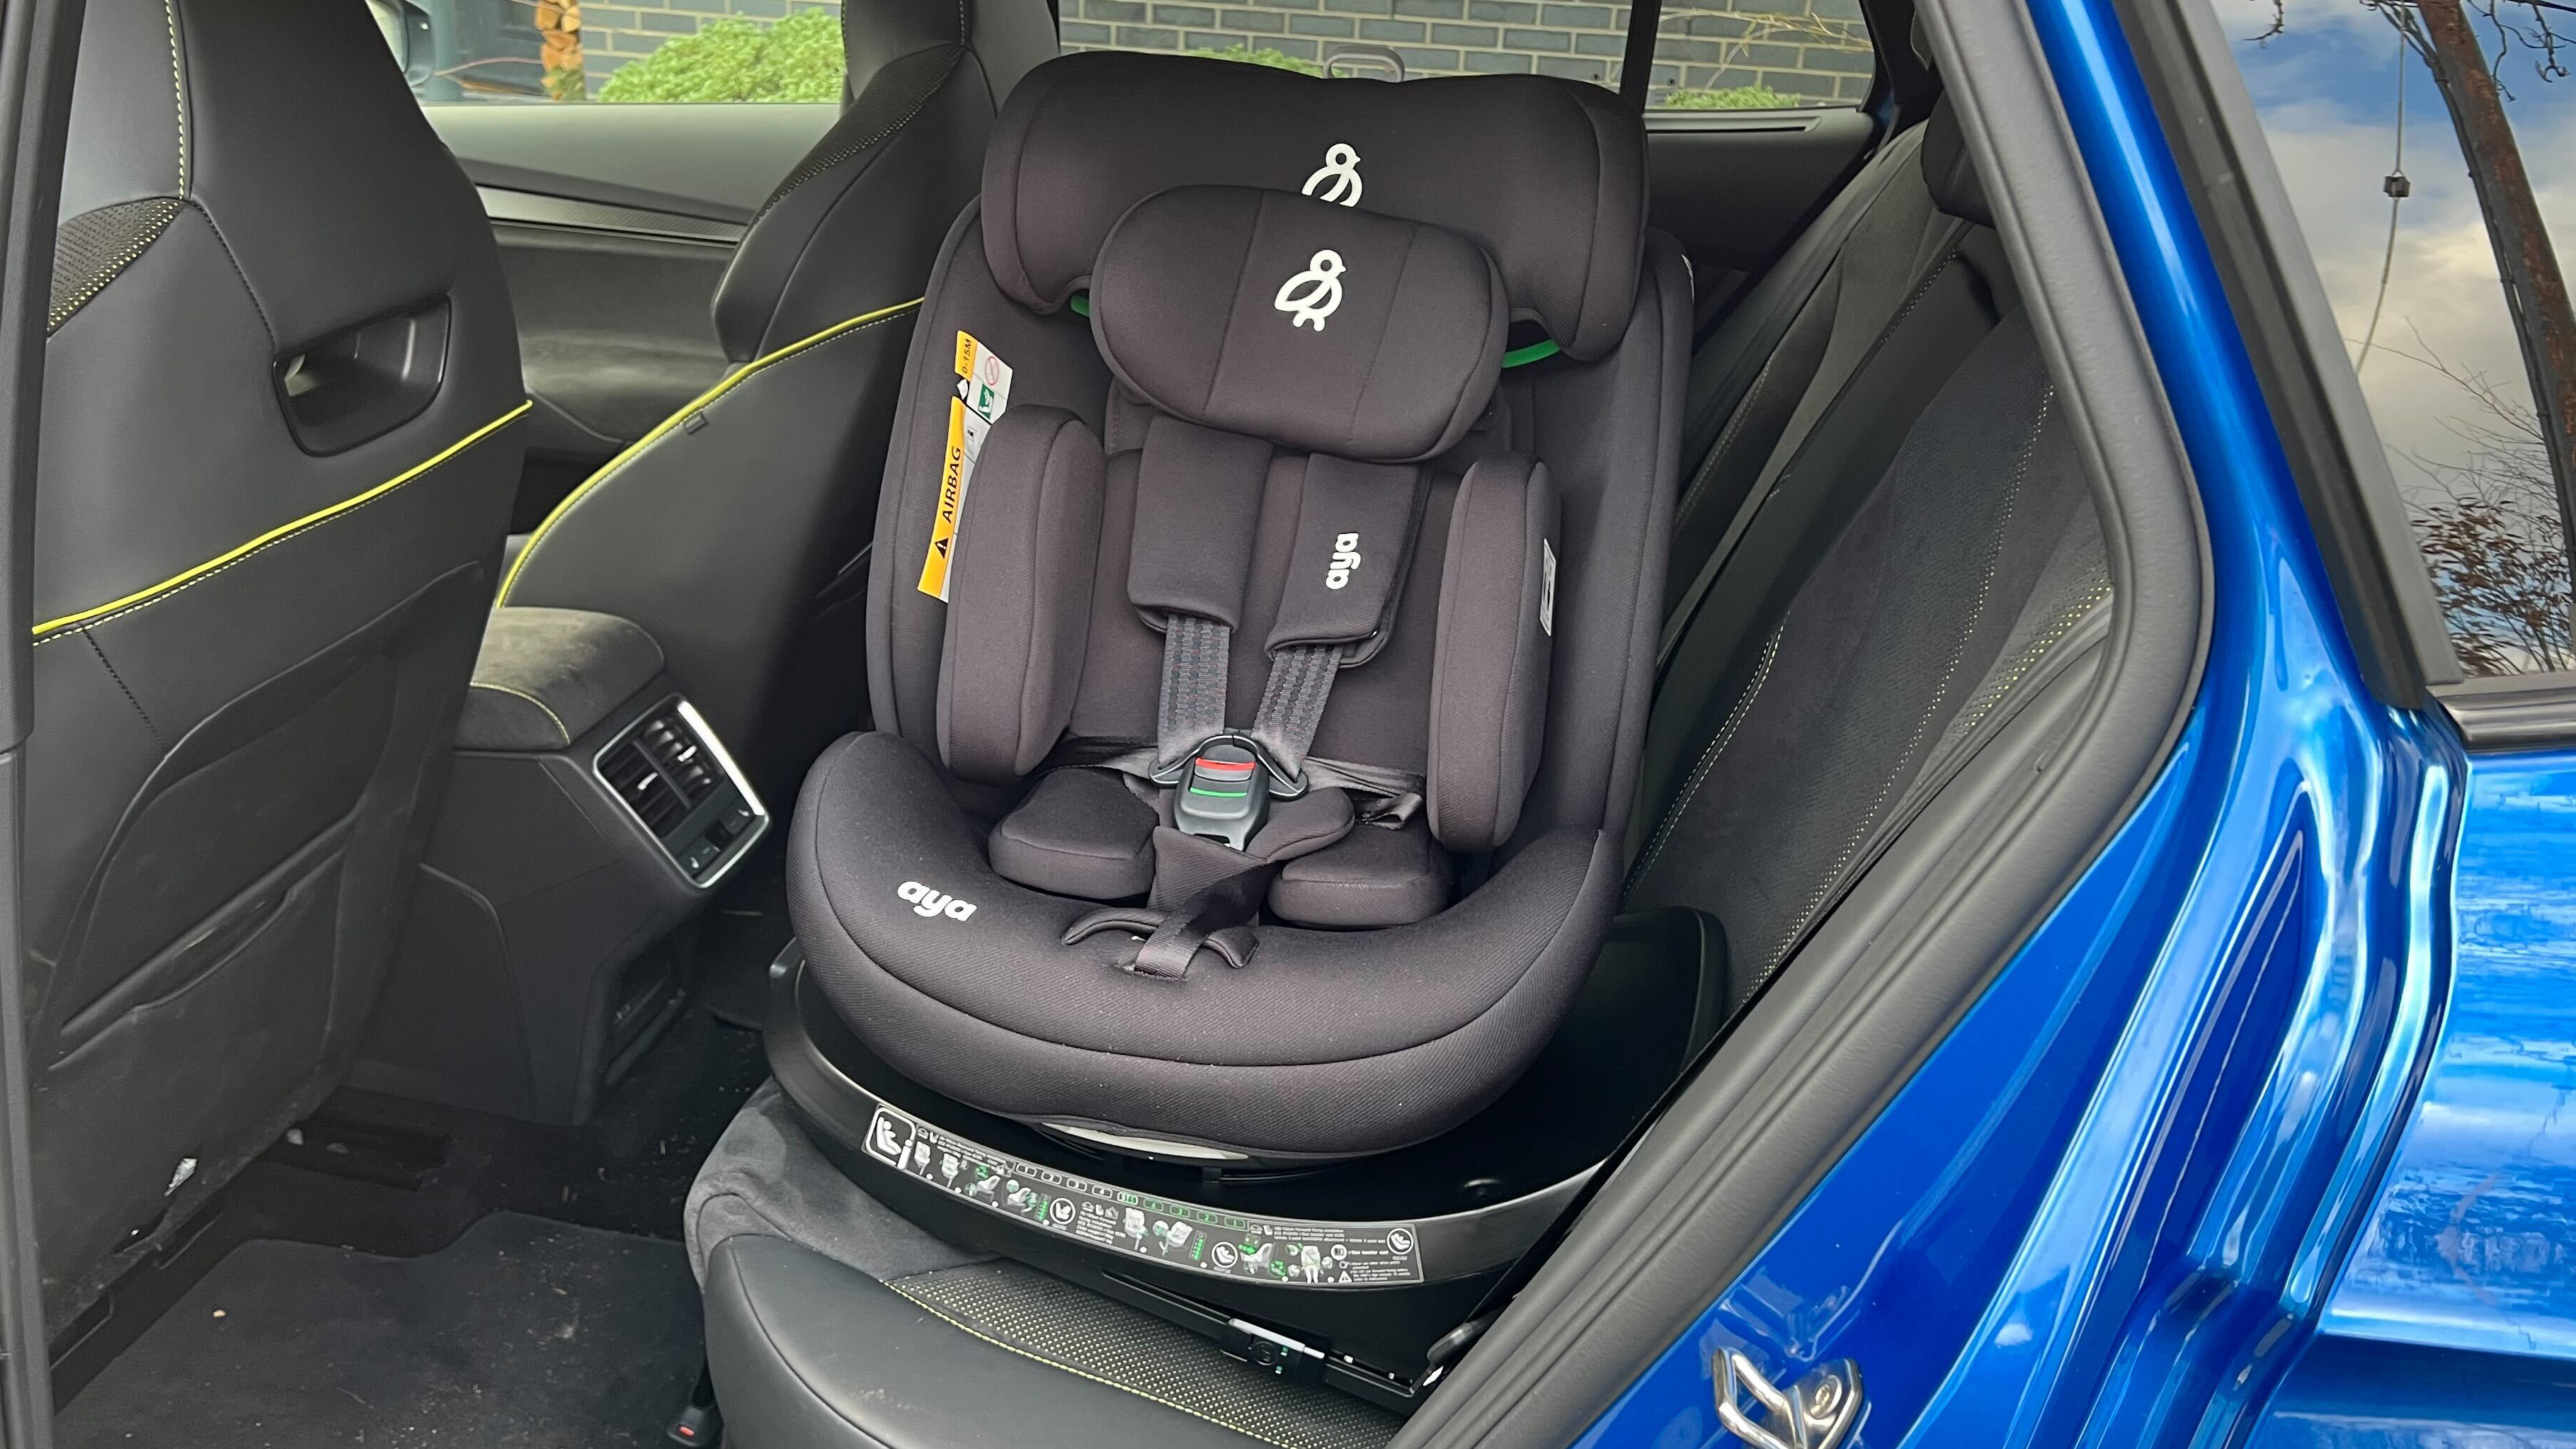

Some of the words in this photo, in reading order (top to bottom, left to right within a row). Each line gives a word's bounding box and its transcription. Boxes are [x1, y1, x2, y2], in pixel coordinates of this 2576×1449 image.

[962, 338, 971, 374] 0-15M
[942, 445, 961, 524] AIRBAG
[1326, 533, 1362, 590] aya
[897, 881, 977, 921] aya
